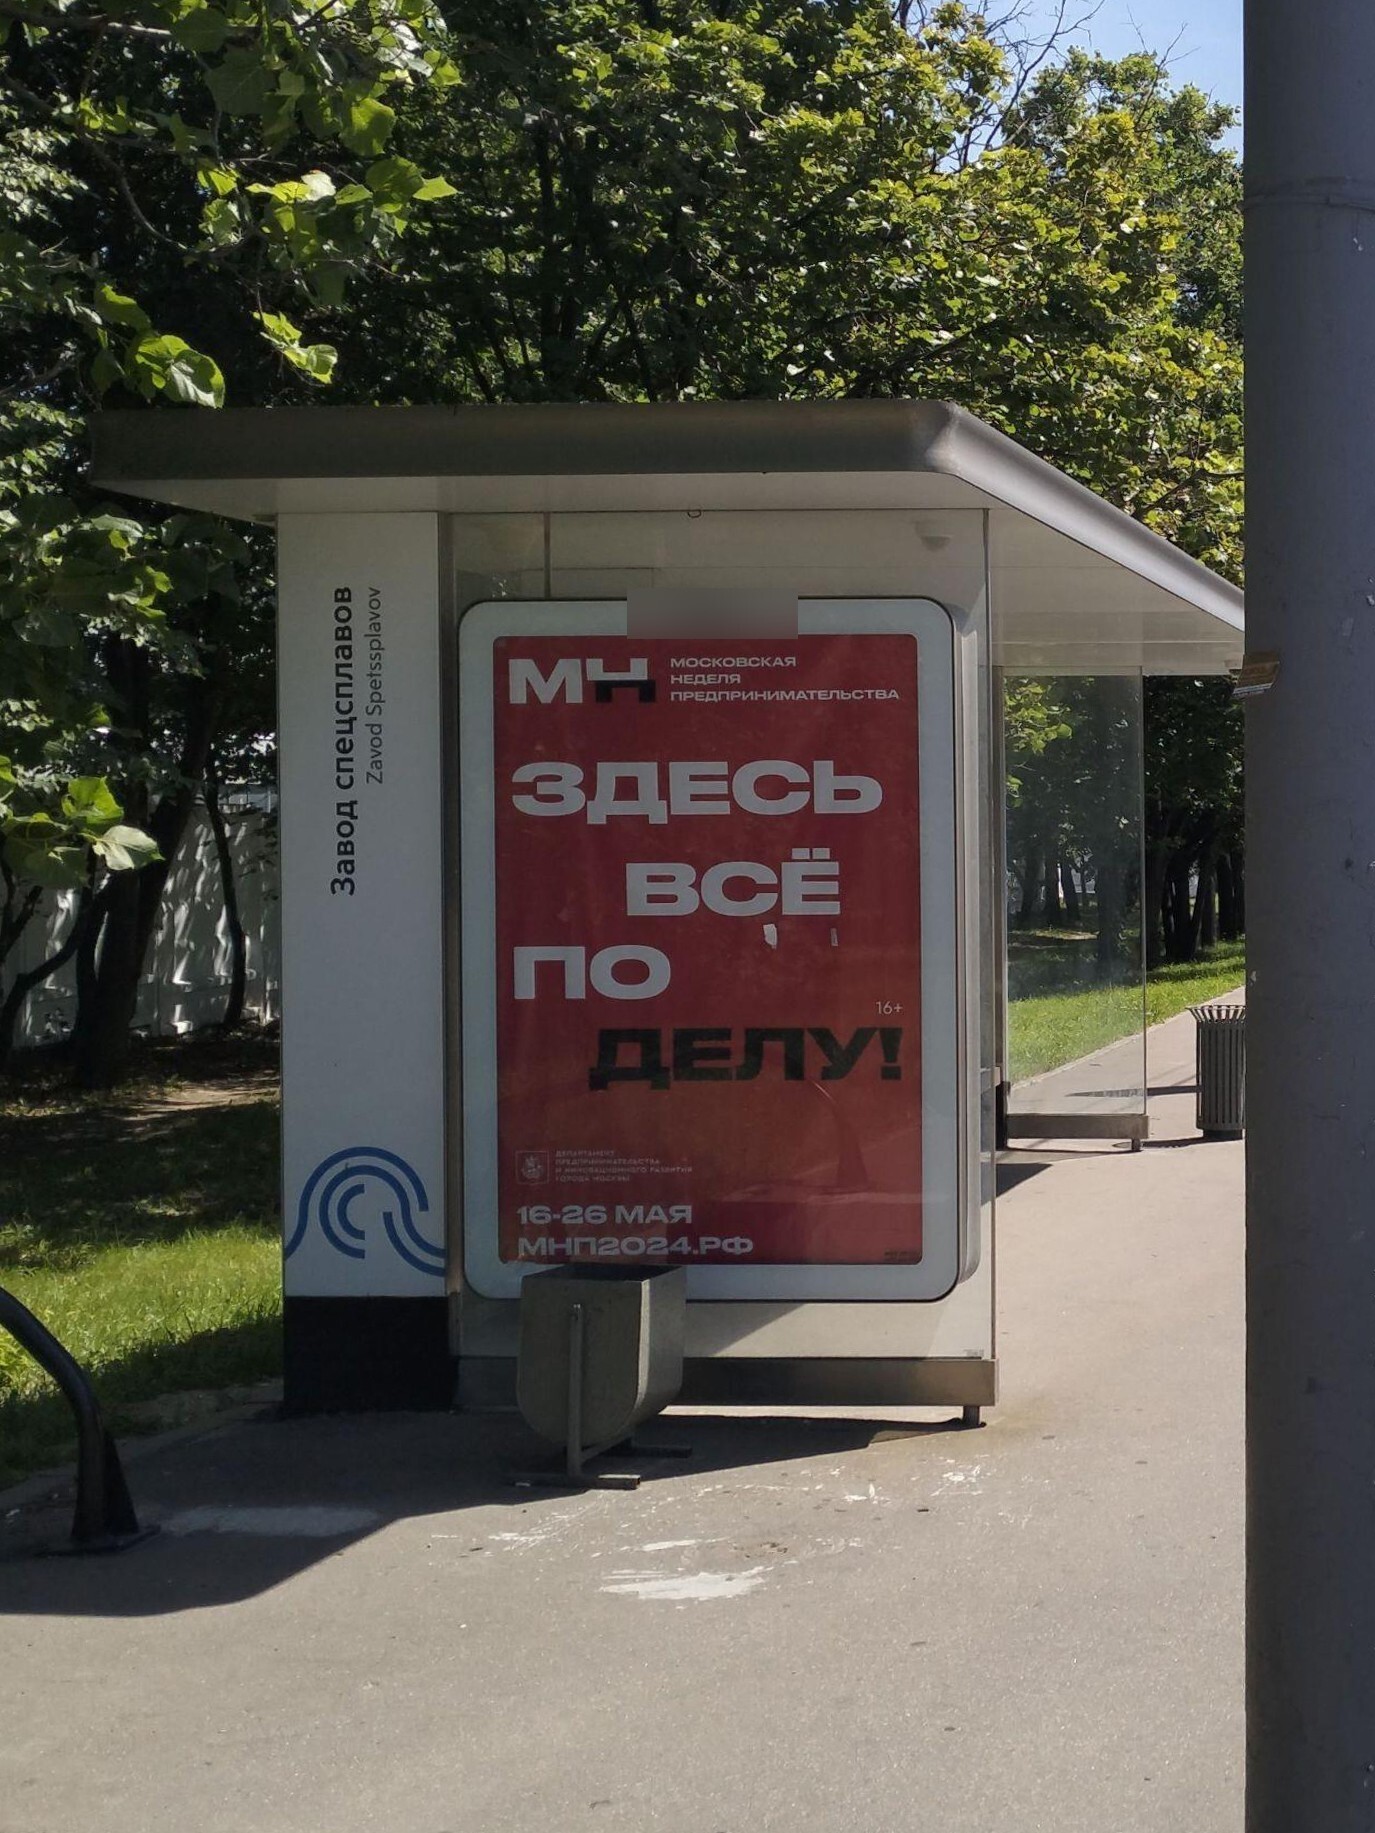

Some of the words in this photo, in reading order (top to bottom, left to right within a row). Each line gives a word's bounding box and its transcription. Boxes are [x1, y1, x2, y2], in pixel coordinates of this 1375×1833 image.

[364, 586, 386, 716] Spetssplavov
[670, 656, 797, 668] МОСКОВСКАЯ
[333, 586, 358, 790] спецсплавов
[508, 657, 656, 704] МН
[670, 673, 742, 686] НЕДЕЛЯ
[670, 688, 900, 703] ПРЕДПРИНИМАТЕЛЬСТВА
[366, 722, 383, 785] Zavod
[511, 759, 883, 825] ЗДЕСЬ
[330, 800, 358, 896] Завод
[625, 847, 841, 917] ВСЁ
[513, 944, 672, 1000] ПО
[875, 1001, 904, 1015] 16+
[588, 1026, 904, 1092] ДЕЛУ!
[516, 1204, 608, 1225] 16-26
[614, 1204, 693, 1225] МАЯ
[517, 1236, 754, 1256] МНП2024.РФ
